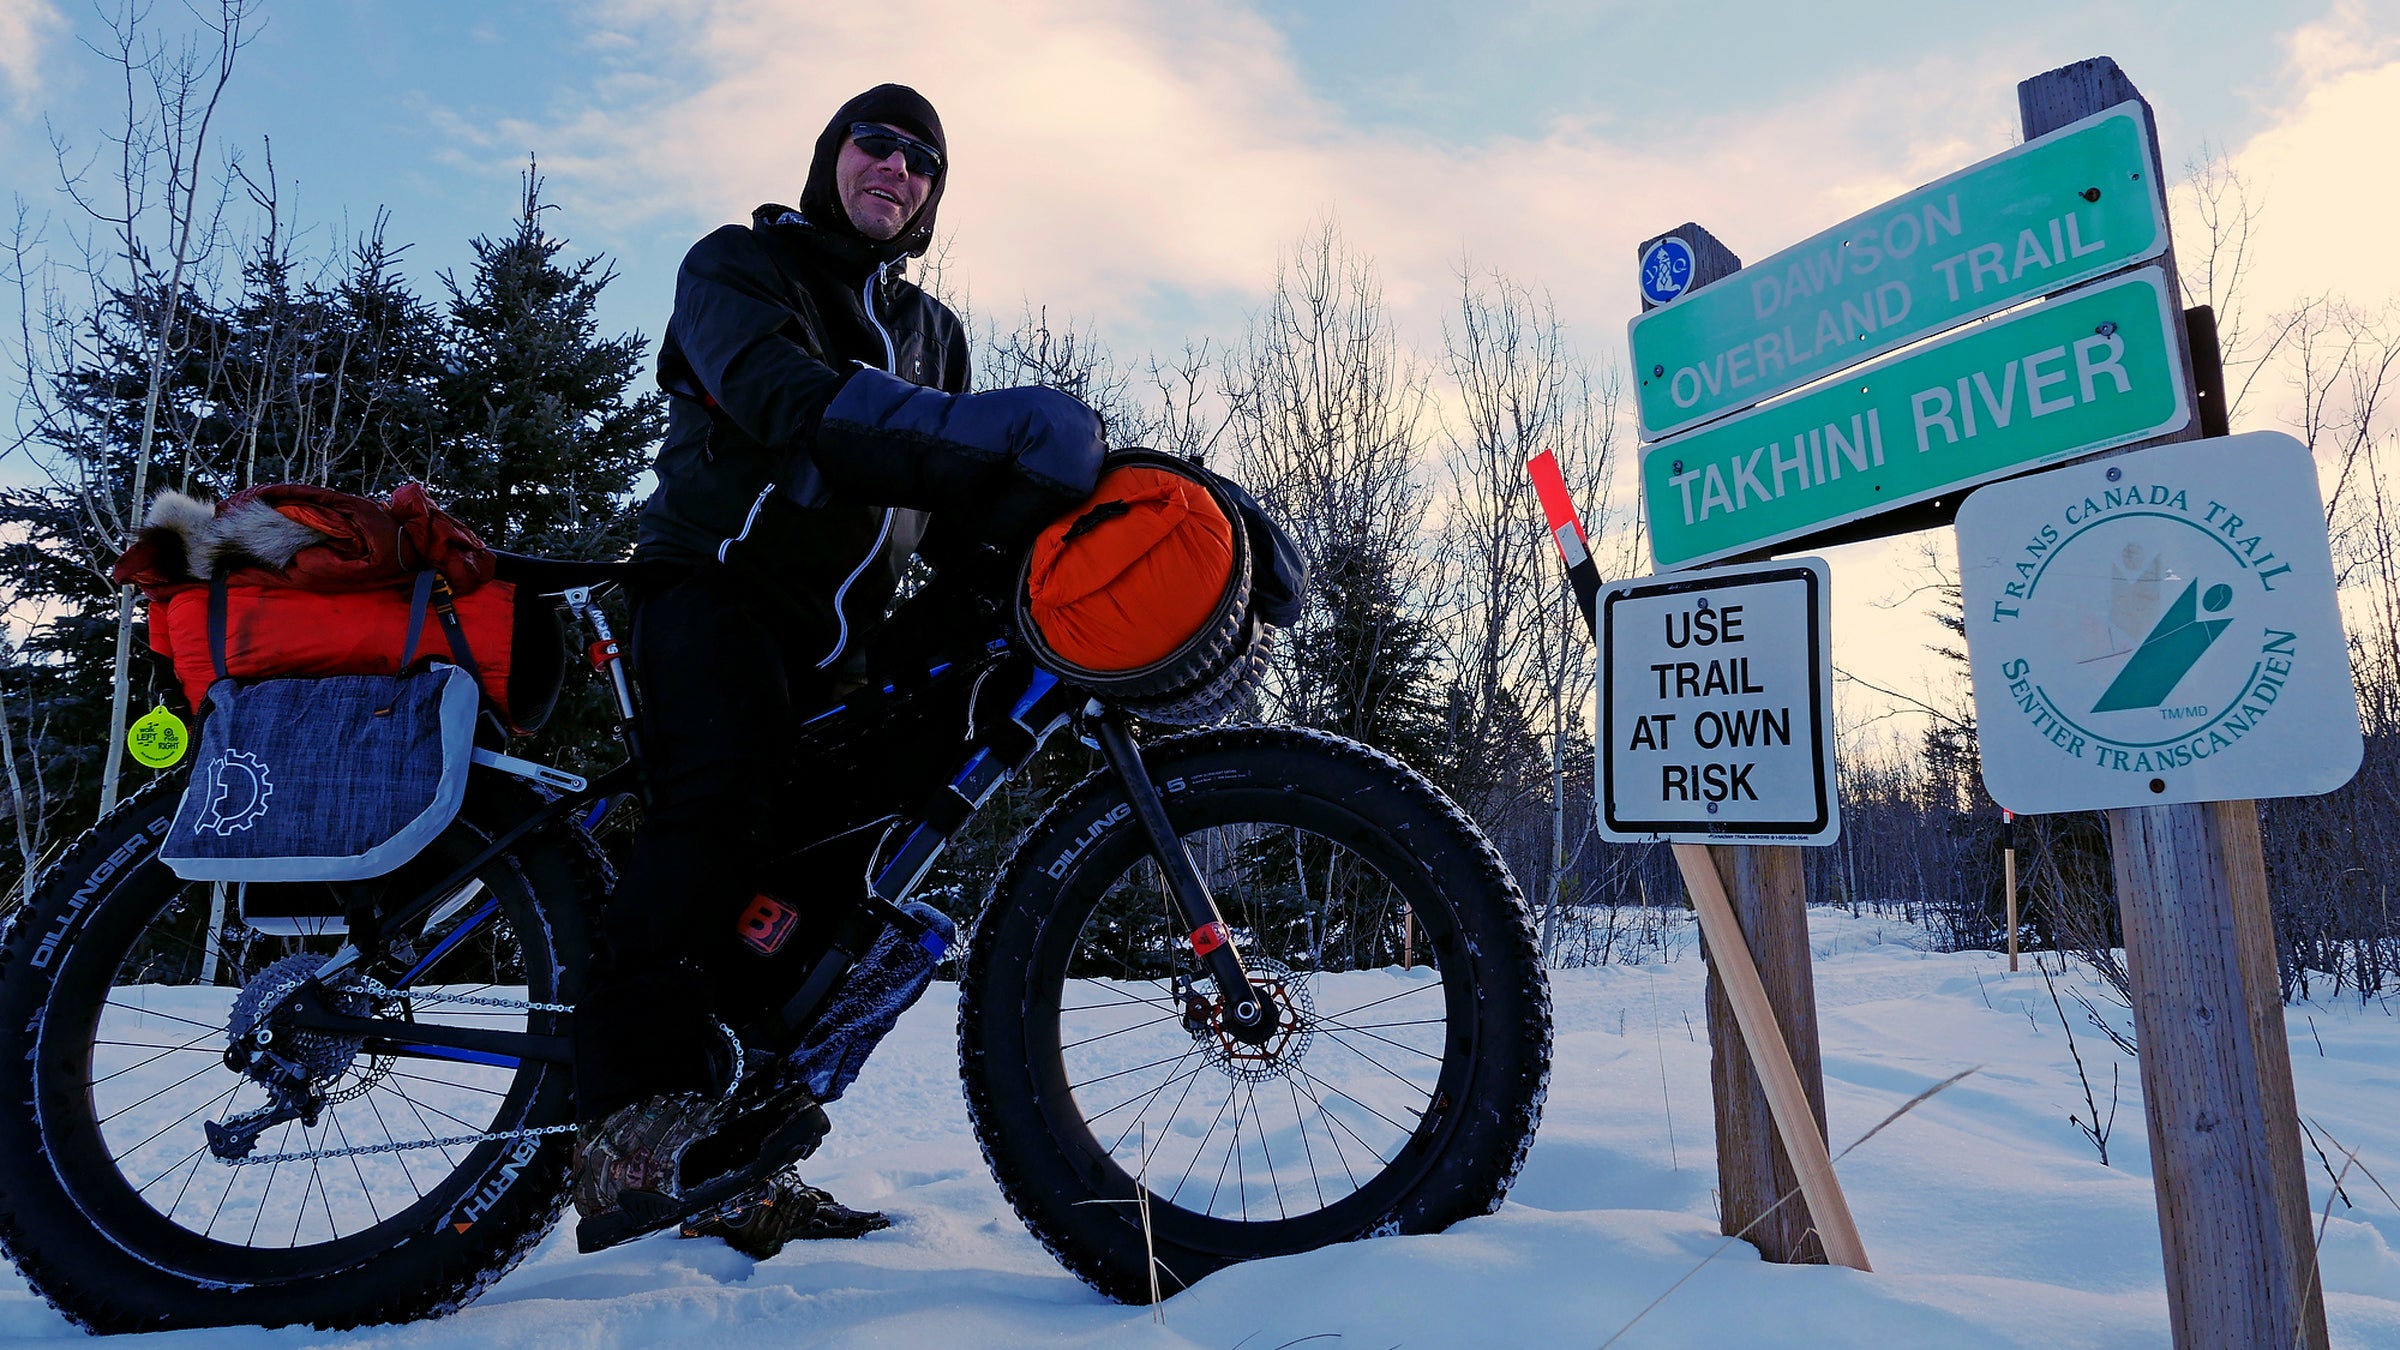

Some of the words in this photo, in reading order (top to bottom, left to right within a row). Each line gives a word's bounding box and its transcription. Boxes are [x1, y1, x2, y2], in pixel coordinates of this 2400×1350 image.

[1751, 194, 1964, 321] DAWSON
[1670, 284, 1911, 409] OVERLAND
[1932, 212, 2106, 302] TRAIL
[1669, 408, 1885, 526] TAKHINI
[1911, 331, 2133, 452] RIVER
[1993, 524, 2059, 624] TRANS
[2065, 484, 2189, 526] CANADA
[2204, 501, 2292, 591] TRAIL
[1664, 606, 1745, 649] USE
[1650, 657, 1764, 699] TRAIL
[2002, 658, 2087, 759] SENTIER
[2096, 627, 2298, 773] TRANSCANADIEN
[2159, 705, 2208, 720] TM/MD
[136, 733, 157, 741] LEFT
[158, 742, 179, 750] RIGHT
[1629, 714, 1676, 751] AT
[1694, 708, 1791, 750] OWN
[1166, 777, 1186, 793] 5
[1662, 763, 1759, 803] RISK
[30, 833, 149, 968] DILLINGER
[147, 815, 171, 836] 5
